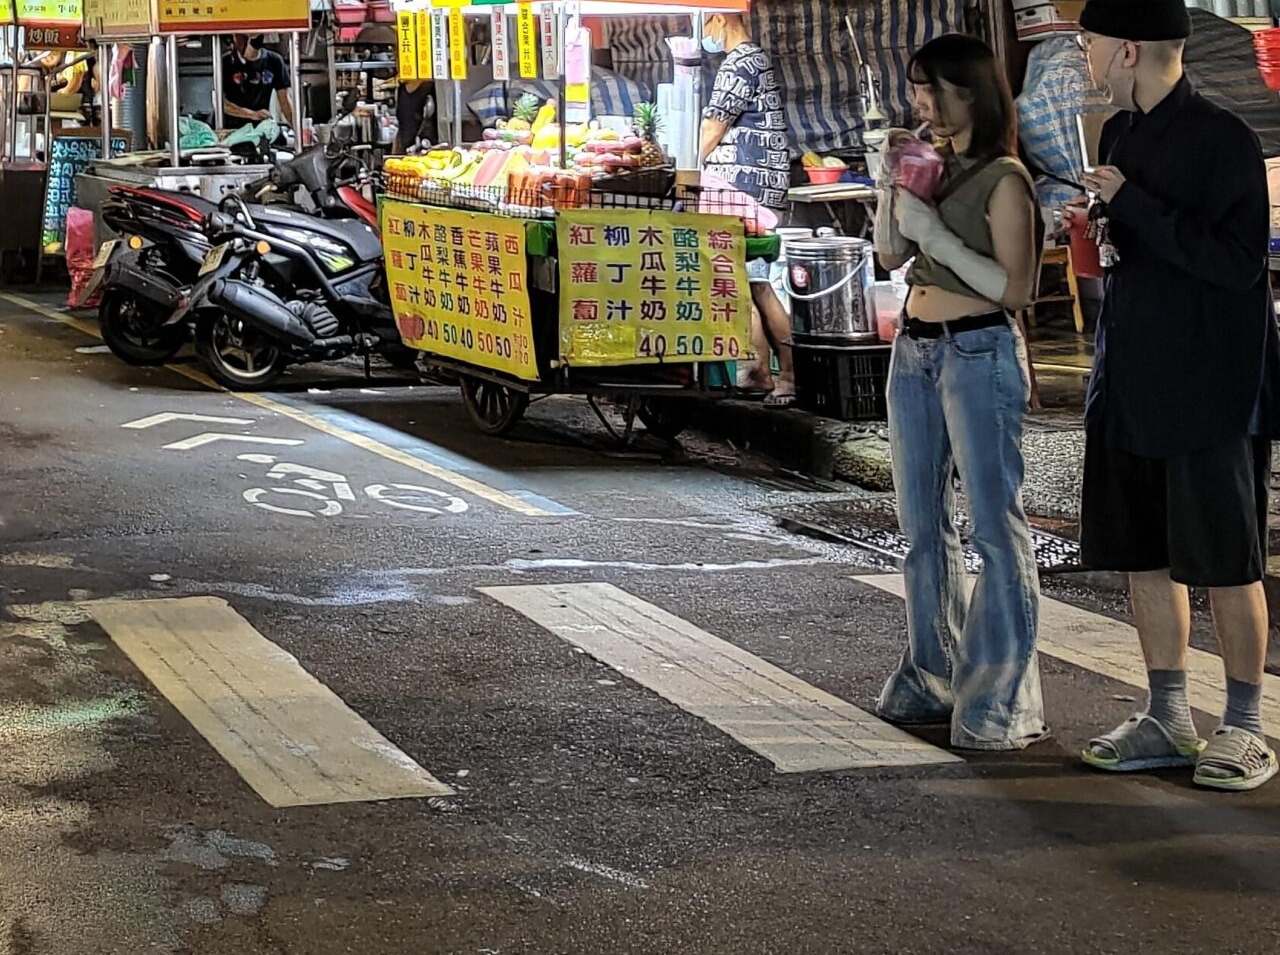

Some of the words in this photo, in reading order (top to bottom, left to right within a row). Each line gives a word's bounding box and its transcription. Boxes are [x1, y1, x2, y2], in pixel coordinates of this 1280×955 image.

[403, 220, 420, 305] 柳丁汁
[418, 221, 437, 308] 木瓜牛奶
[433, 224, 454, 312] 酪梨牛奶
[450, 226, 471, 316] 香蕉牛奶
[467, 229, 490, 320] 芒果牛奶
[484, 231, 508, 324] 蘋果牛奶
[504, 234, 526, 328] 西瓜汁
[569, 225, 599, 321] 紅蘿蔔
[603, 225, 633, 321] 柳丁汁
[637, 225, 668, 321] 木瓜牛奶
[672, 228, 704, 322] 酪梨牛奶
[706, 230, 739, 323] 綜合果汁
[443, 323, 458, 344] 50
[460, 328, 474, 350] 40
[477, 332, 493, 354] 50
[495, 334, 512, 358] 50
[639, 334, 667, 358] 40
[676, 335, 704, 357] 50
[712, 335, 740, 359] 50
